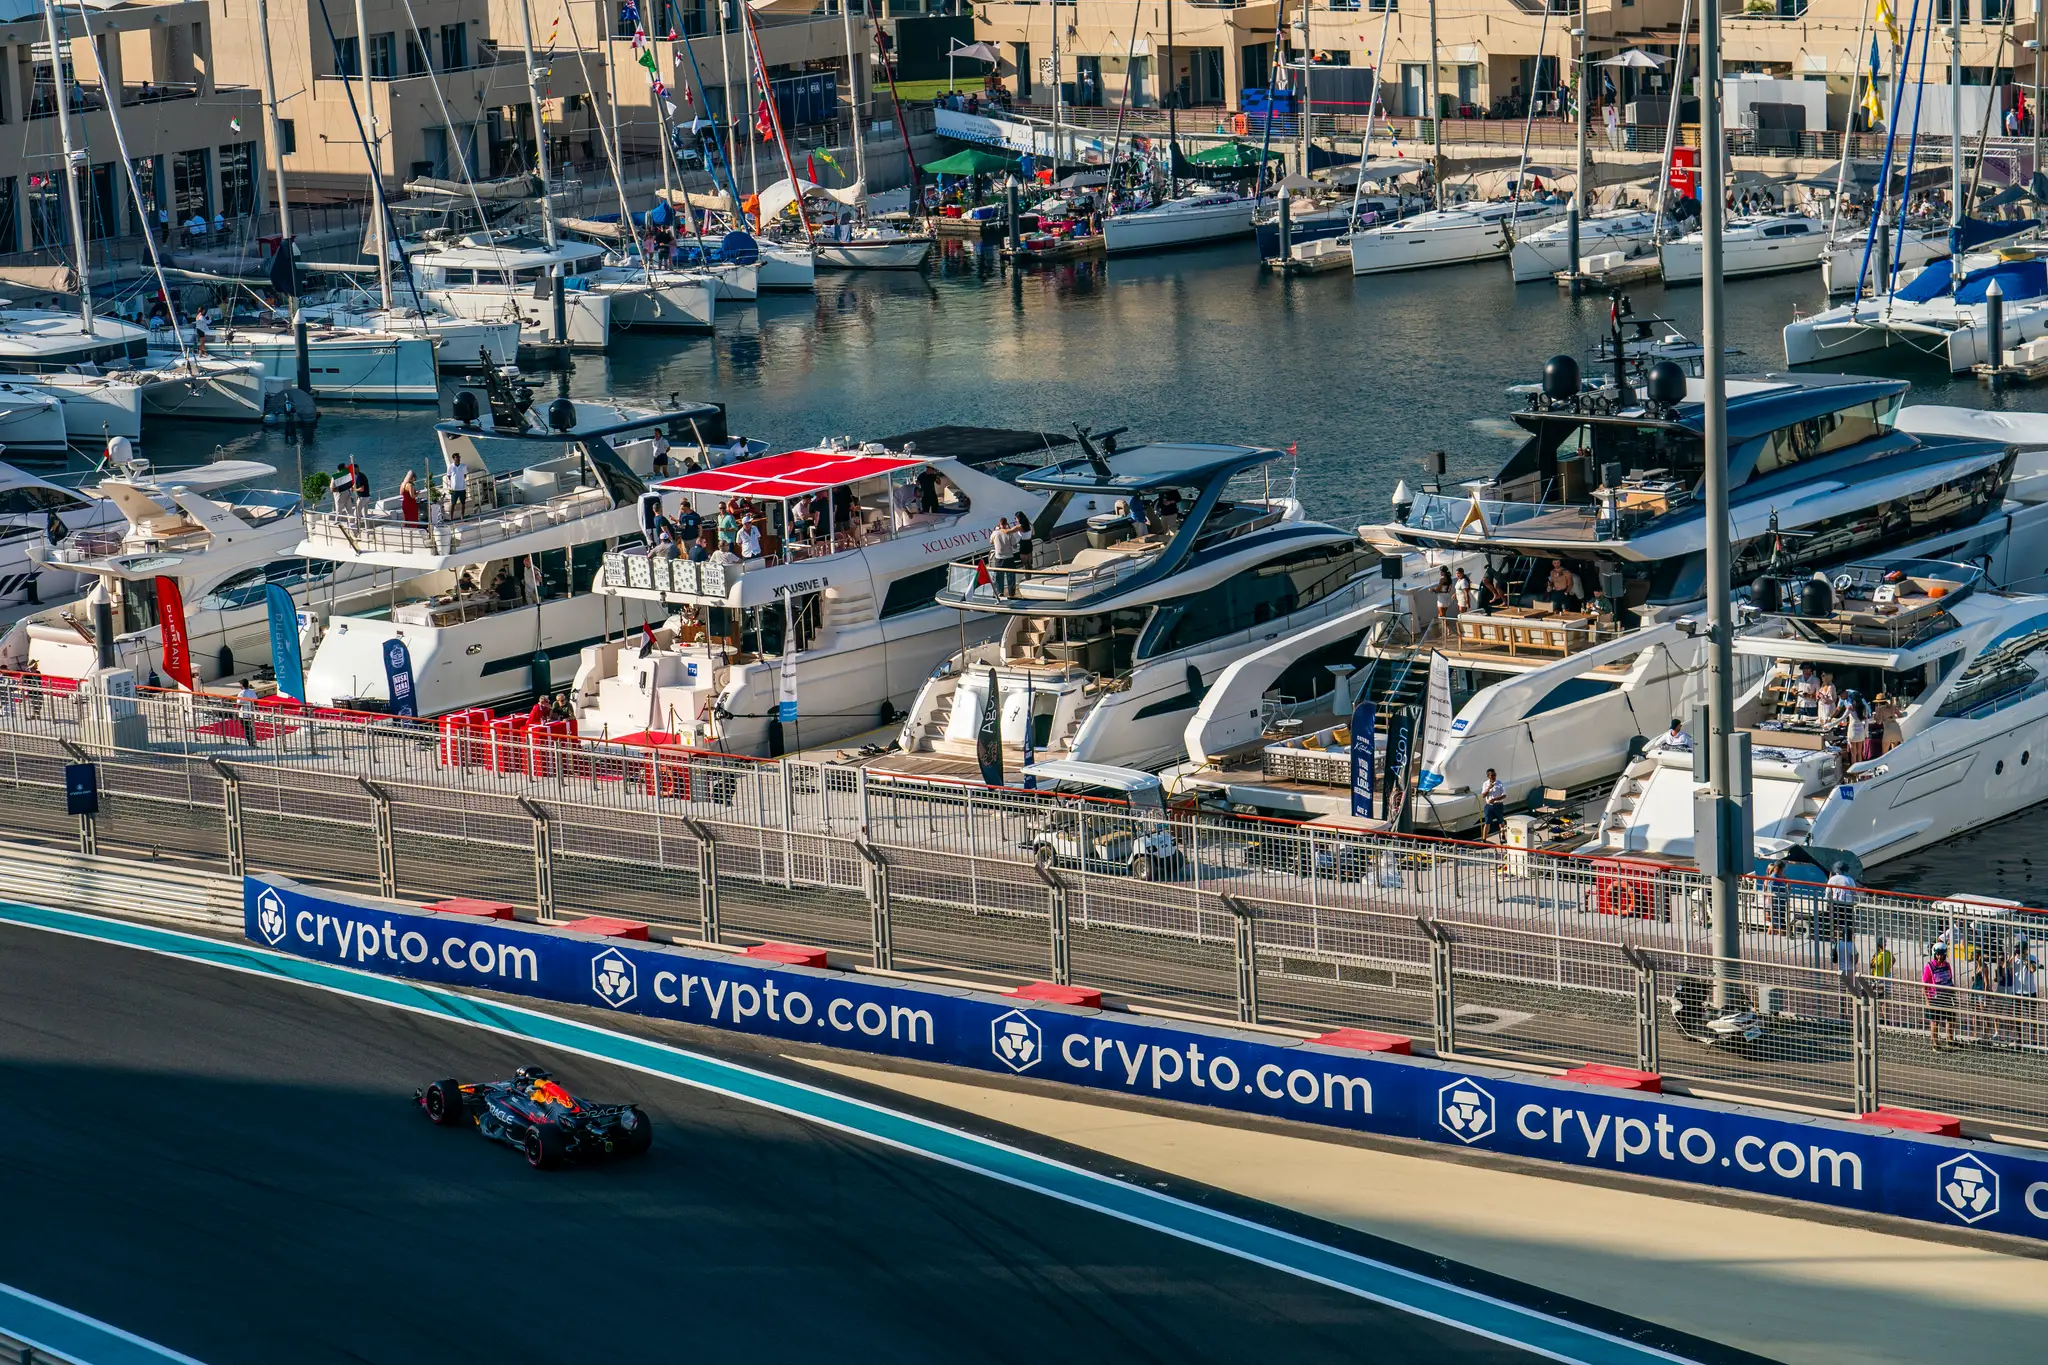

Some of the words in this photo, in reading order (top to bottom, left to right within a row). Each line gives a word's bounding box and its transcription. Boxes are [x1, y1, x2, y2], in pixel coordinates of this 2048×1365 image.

[609, 560, 620, 568] NUSA
[922, 532, 979, 554] XCLUSIVE
[707, 577, 719, 585] CANA
[166, 604, 180, 670] DUBRIANI
[275, 613, 286, 680] DUBRIANI
[982, 686, 997, 734] Ago
[1390, 728, 1408, 778] Agon
[1357, 777, 1370, 791] LOCAL
[296, 910, 538, 982] crypto.com
[654, 971, 934, 1046] crypto.com
[1063, 1033, 1374, 1114] crypto.com
[576, 1105, 631, 1119] ORACLE
[1516, 1103, 1862, 1191] crypto.com
